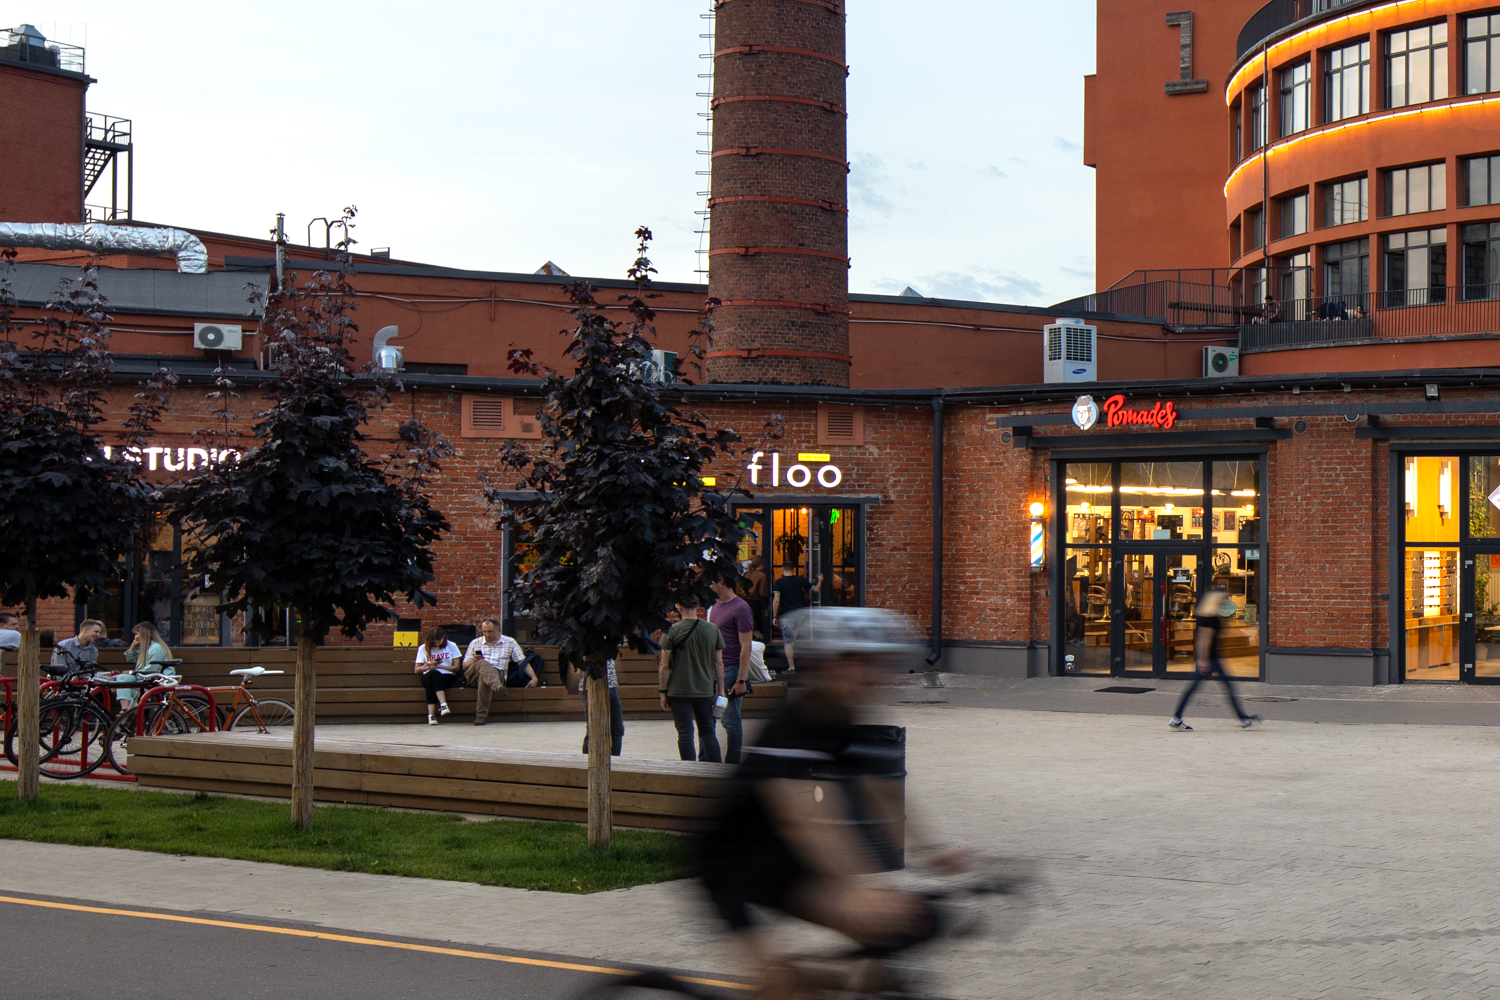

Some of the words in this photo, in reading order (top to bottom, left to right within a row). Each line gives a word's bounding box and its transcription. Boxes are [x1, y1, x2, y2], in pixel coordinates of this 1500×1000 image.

[1165, 10, 1208, 95] 1
[1103, 394, 1178, 430] Pomades
[746, 451, 842, 488] floo
